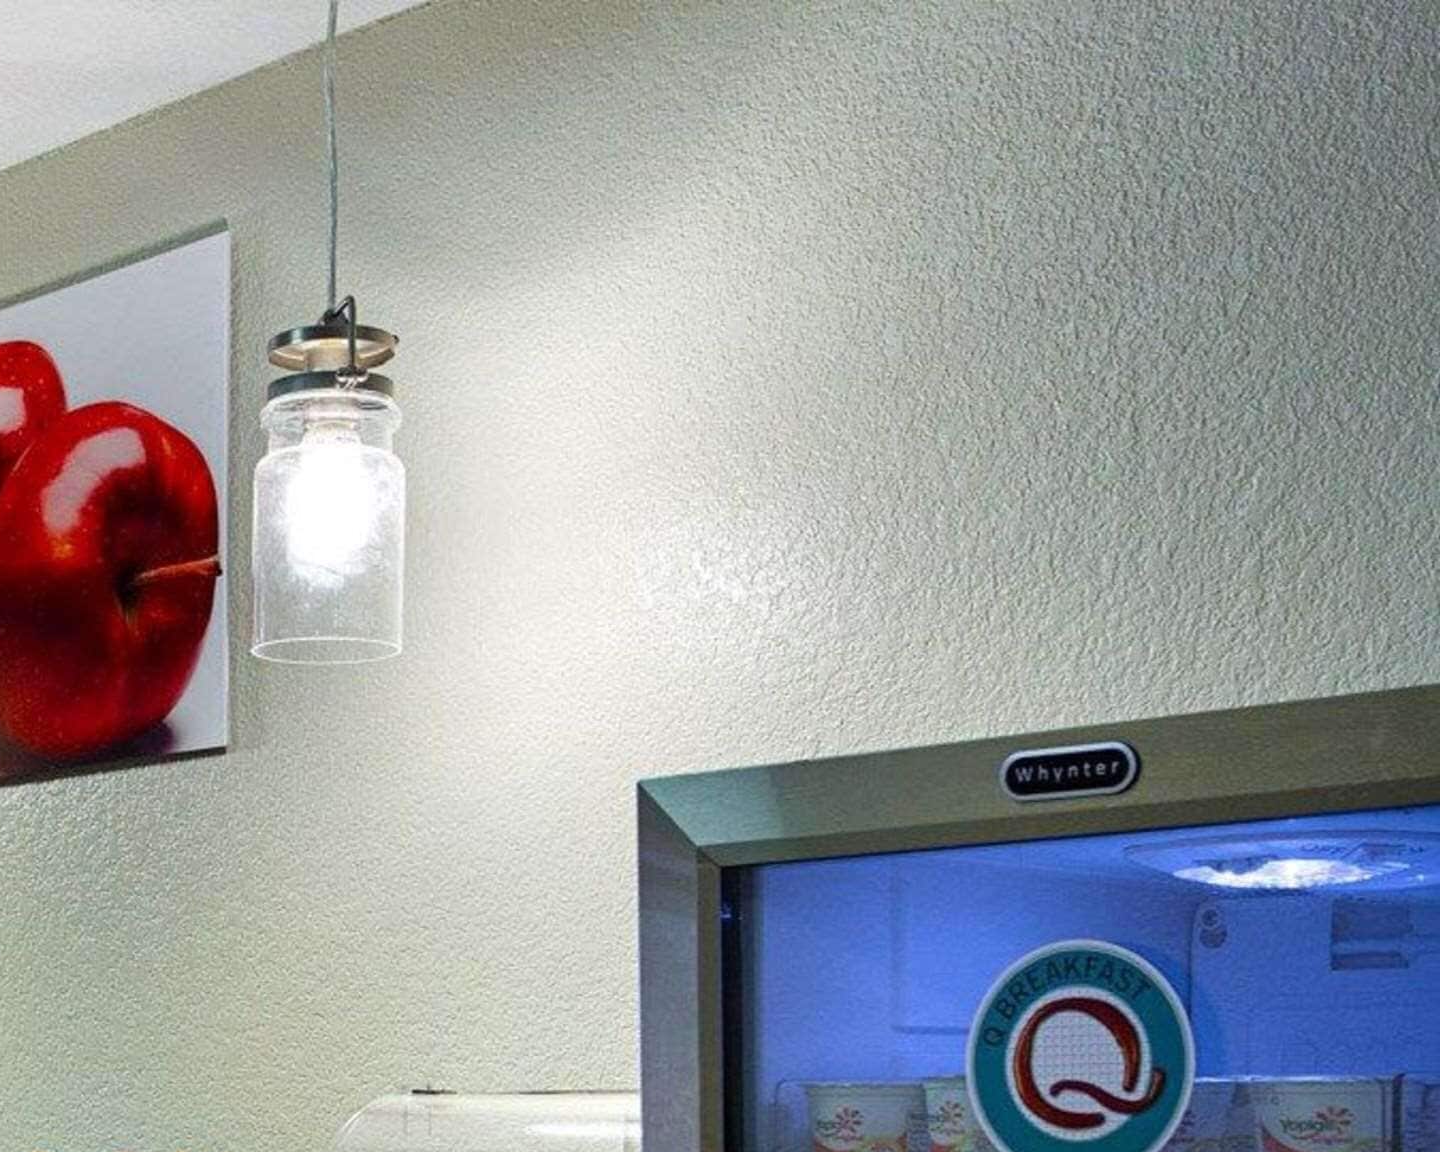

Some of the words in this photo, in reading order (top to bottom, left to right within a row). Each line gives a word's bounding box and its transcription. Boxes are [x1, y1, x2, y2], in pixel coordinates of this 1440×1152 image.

[1015, 761, 1120, 782] Whynter
[982, 1026, 1004, 1047] Q
[997, 956, 1153, 1021] BREAKFAST
[1013, 997, 1166, 1130] Q
